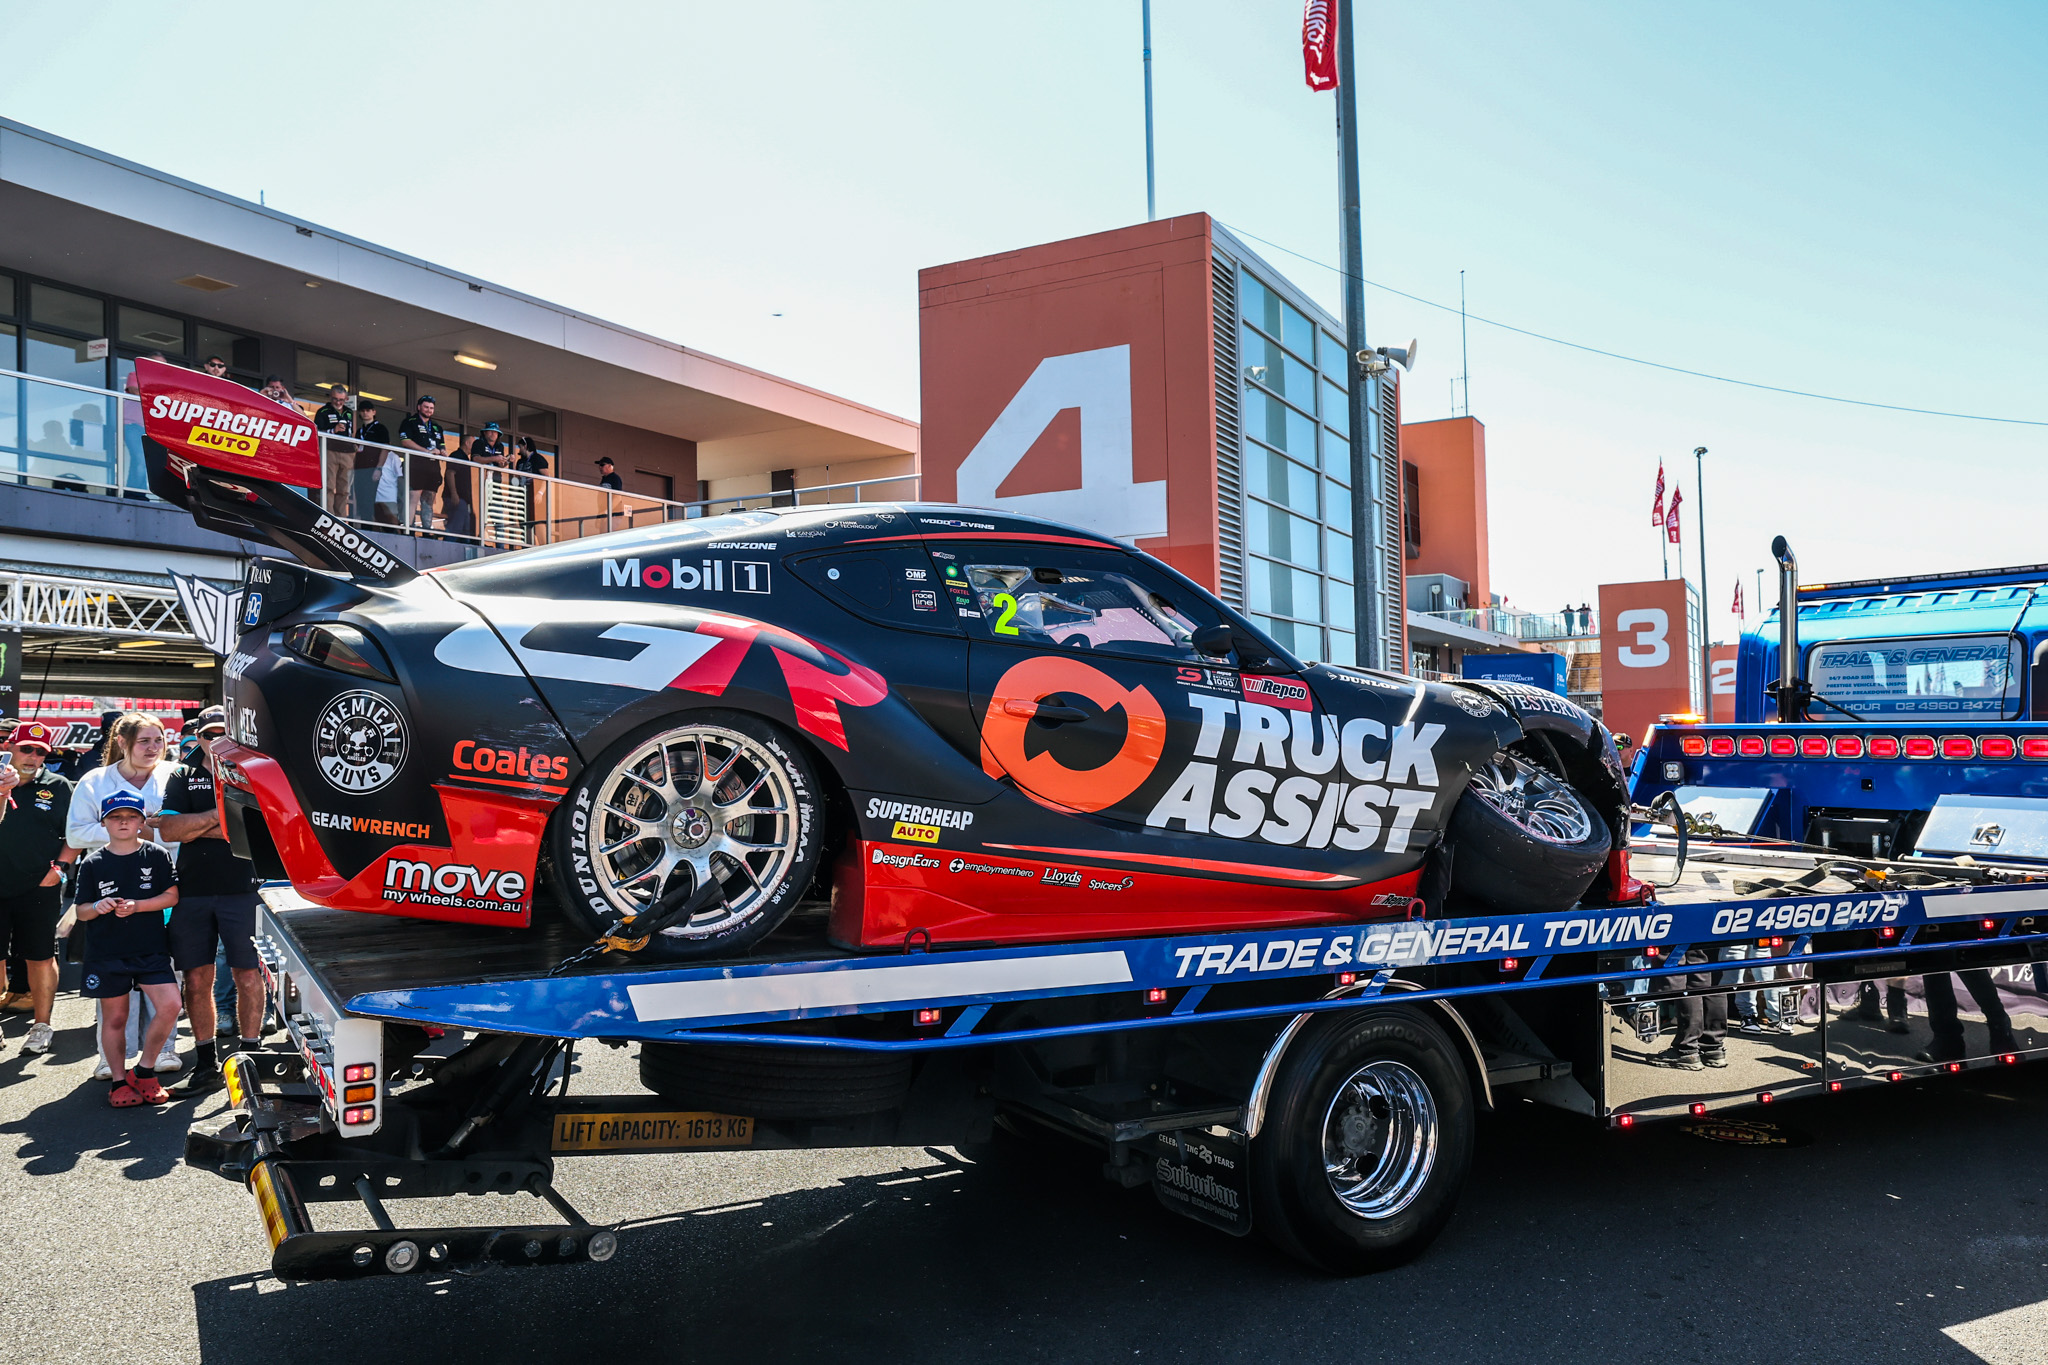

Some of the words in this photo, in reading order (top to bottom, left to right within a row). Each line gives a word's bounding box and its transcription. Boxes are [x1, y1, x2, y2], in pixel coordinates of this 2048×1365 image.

[149, 395, 312, 447] SUPERCHEAP
[195, 432, 251, 451] AUTO
[956, 343, 1168, 548] 4
[961, 522, 995, 531] EVANS
[311, 527, 328, 541] SUPER
[327, 537, 352, 557] PREMIUM
[351, 551, 365, 564] RAW
[363, 561, 374, 572] PET
[371, 568, 387, 579] FOOD
[314, 514, 396, 574] PROUDI
[707, 543, 777, 551] SIGNZONE
[602, 558, 724, 592] Mobil
[744, 564, 757, 591] 1
[905, 571, 927, 579] OMP
[915, 598, 934, 606] line
[950, 588, 970, 596] FOXTEL
[246, 596, 262, 622] PPG
[993, 592, 1019, 636] 2
[1617, 608, 1670, 668] 3
[1820, 651, 1888, 668] TRADE
[1888, 649, 1907, 666] &
[1907, 645, 2014, 666] GENERAL
[1213, 678, 1235, 687] 1000
[1261, 678, 1307, 700] Repco
[1339, 674, 1400, 690] DUNLOP
[1711, 659, 1738, 694] 2
[1844, 703, 1881, 711] HOUR
[1895, 702, 1915, 711] 02
[1918, 701, 1960, 710] 4960
[1962, 701, 2005, 710] 2475
[320, 698, 401, 748] CHEMICAL
[1186, 691, 1446, 788] TRUCK
[452, 739, 569, 780] Coates
[329, 761, 382, 787] GUYS
[866, 798, 974, 831] SUPERCHEAP
[1146, 761, 1436, 854] ASSIST
[312, 811, 431, 839] GEARWRENCH
[896, 826, 935, 839] AUTO
[571, 786, 611, 915] DUNLOP
[872, 850, 941, 868] DesignEars
[385, 859, 526, 899] move
[1042, 867, 1082, 884] Lloyds
[1088, 879, 1123, 891] Spicers
[384, 888, 405, 903] my
[410, 891, 521, 913] wheels.com.au
[1175, 943, 1320, 978] TRADE
[1322, 936, 1354, 966] &
[1359, 923, 1530, 963] GENERAL
[1543, 914, 1673, 948] TOWING
[1711, 908, 1750, 935] 02
[1761, 904, 1831, 931] 4960
[1832, 899, 1901, 926] 2475
[560, 1121, 596, 1143] LIFT
[599, 1119, 681, 1142] CAPACITY:
[686, 1118, 723, 1139] 1613
[727, 1117, 747, 1138] KG
[1199, 1144, 1213, 1164] 25
[1213, 1154, 1235, 1169] YEARS
[1156, 1157, 1239, 1209] Suburban
[1160, 1183, 1189, 1202] TOWING
[1191, 1195, 1239, 1222] EQUIPMENT
